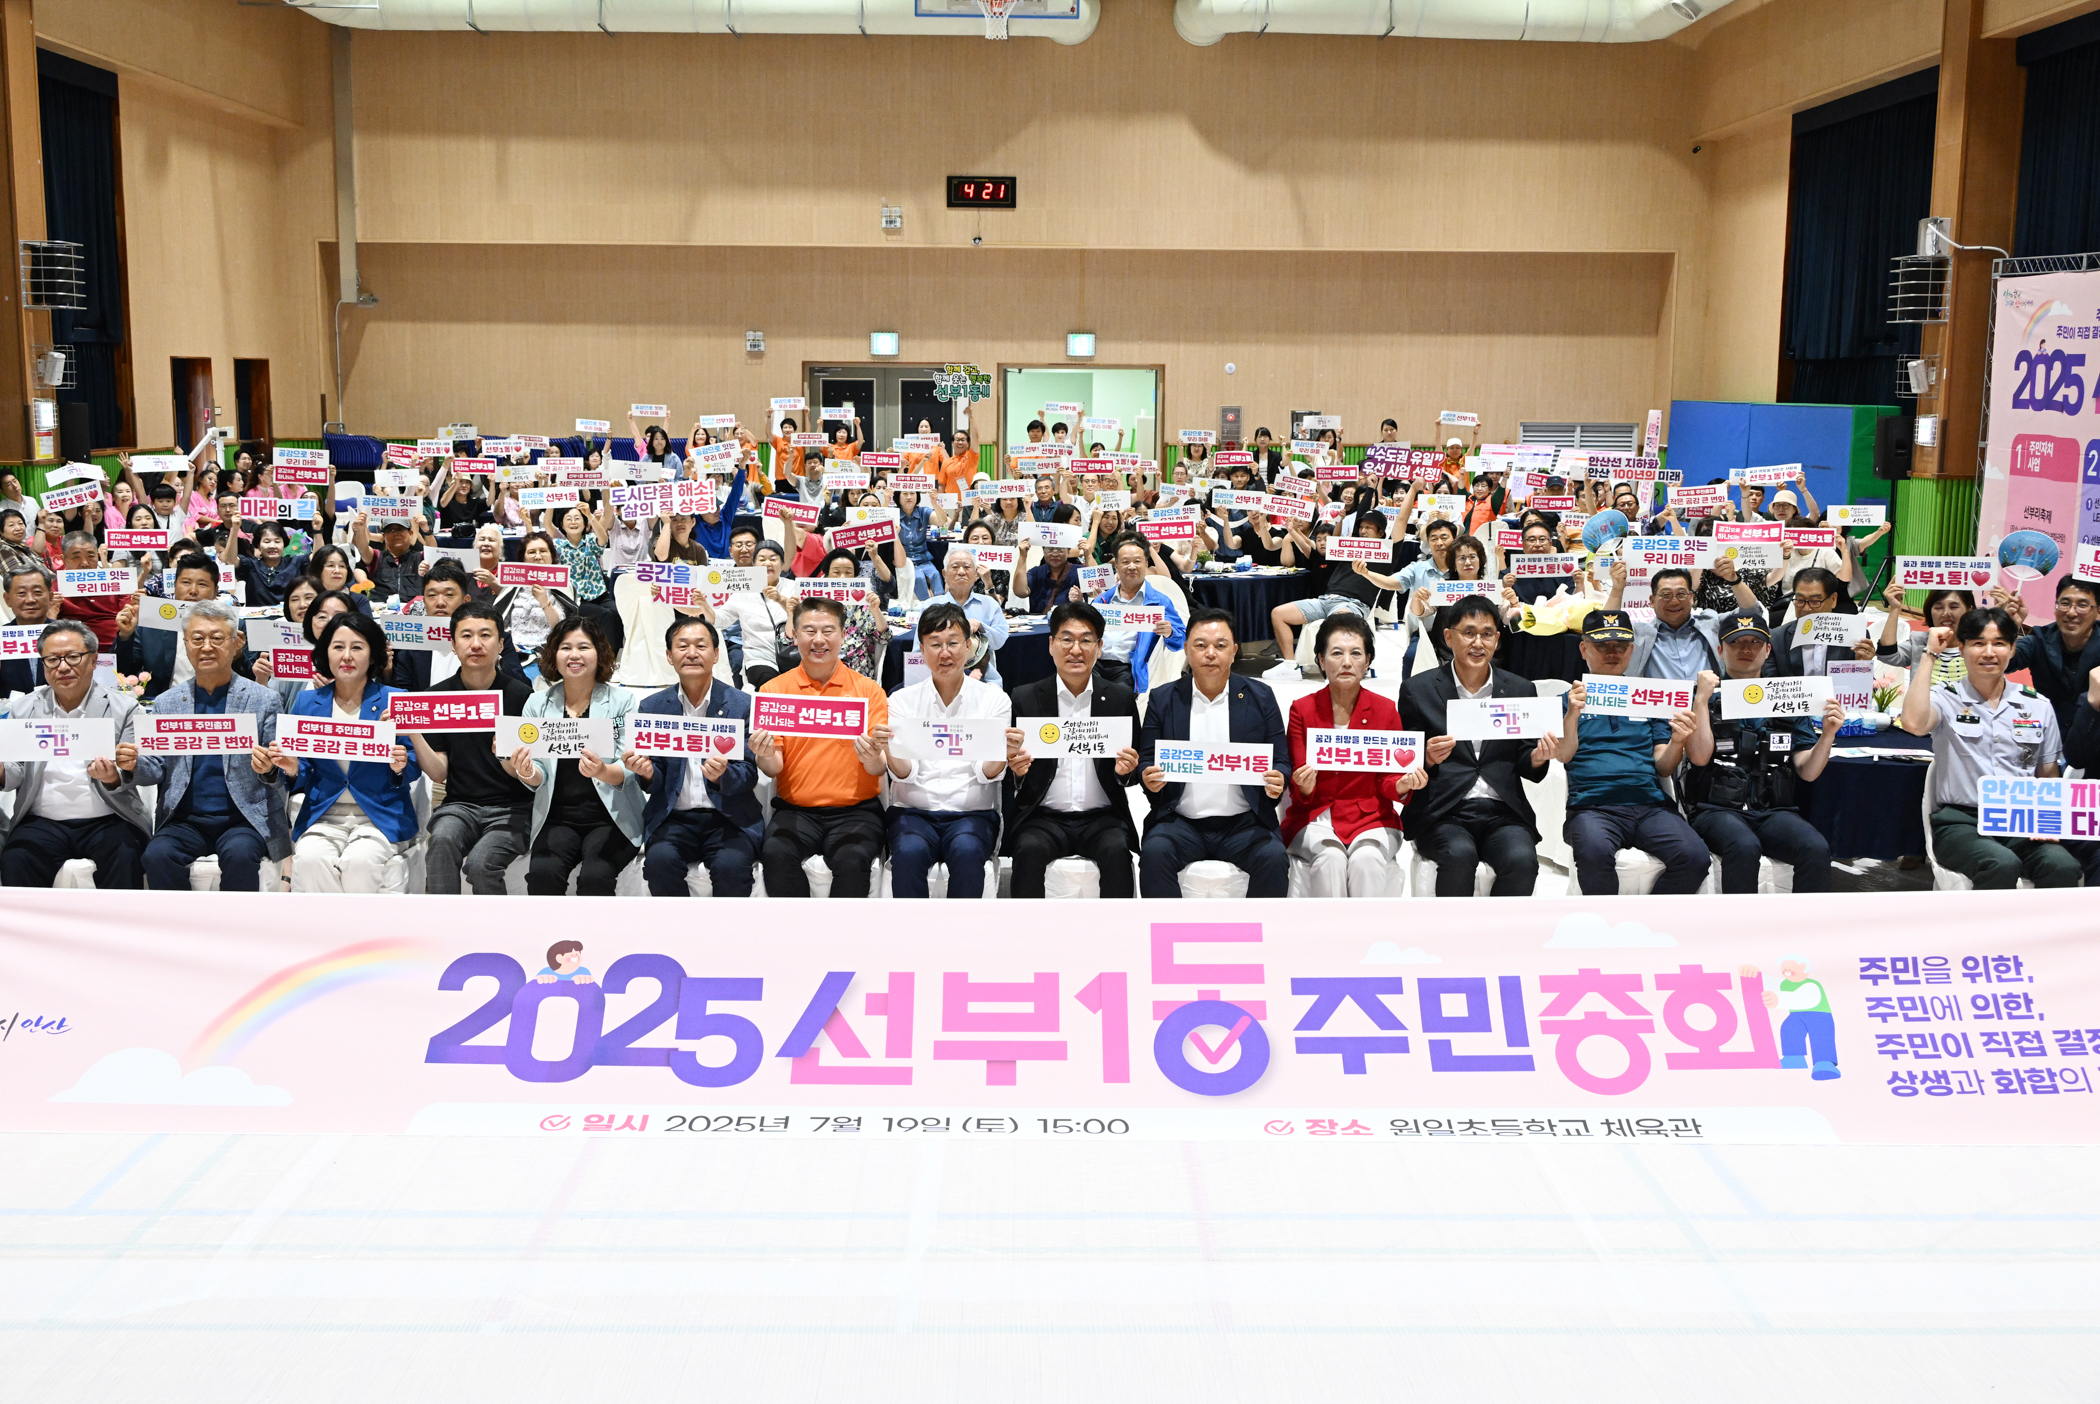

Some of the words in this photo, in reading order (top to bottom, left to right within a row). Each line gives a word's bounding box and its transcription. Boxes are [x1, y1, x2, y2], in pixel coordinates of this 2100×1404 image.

[982, 183, 1004, 199] 21
[2056, 326, 2075, 339] 주민이
[2077, 326, 2090, 340] 직접
[946, 366, 960, 374] 함께
[935, 375, 949, 383] 함께
[969, 375, 991, 384] 행복한
[2012, 349, 2086, 416] 2025
[935, 385, 990, 402] 선부1동!!
[696, 446, 720, 456] 공감으로
[1366, 447, 1408, 463] “수도권
[1410, 451, 1444, 465] 유일”
[2016, 444, 2022, 468] 1
[2029, 441, 2054, 457] 주민자치
[1088, 462, 1112, 470] 선부1동
[1589, 457, 1622, 468] 안산선
[1625, 457, 1659, 469] 지하화
[2028, 458, 2040, 472] 사업
[2087, 450, 2098, 476] 2
[1362, 462, 1386, 475] 우선
[1389, 464, 1410, 478] 사업
[1413, 467, 1441, 482] 선정!
[1589, 469, 1610, 479] 안산
[1613, 470, 1655, 480] 100년의
[1658, 471, 1680, 482] 미래
[612, 484, 672, 503] 도시단절
[678, 481, 713, 496] 해소!
[1000, 485, 1025, 493] 선부1동
[240, 499, 292, 518] 미래의
[297, 500, 314, 519] 길
[624, 502, 653, 518] 삶의
[659, 501, 674, 512] 질
[679, 497, 714, 511] 상승!
[1549, 499, 1573, 507] 선부1동
[1153, 508, 1180, 517] 공감으로
[2024, 506, 2052, 524] 선부리축제
[857, 525, 892, 540] 선부1동
[1161, 526, 1192, 535] 선부1동
[1742, 527, 1780, 538] 선부1동
[1632, 539, 1680, 550] 공감으로
[1684, 540, 1708, 551] 잇는
[1800, 533, 1833, 543] 선부1동
[978, 551, 1013, 563] 선부1동
[1644, 553, 1667, 564] 우리
[1671, 554, 1695, 565] 마을
[65, 571, 106, 582] 공감으로
[109, 570, 129, 581] 잇는
[527, 570, 565, 582] 선부1동
[637, 563, 691, 584] 공간을
[1904, 570, 1968, 586] 선부1동!
[77, 584, 97, 593] 우리
[100, 583, 121, 593] 마을
[1437, 583, 1474, 592] 공감으로
[1477, 583, 1496, 592] 잇는
[385, 622, 423, 632] 공감으로
[277, 653, 308, 661] 공감으로
[278, 665, 309, 674] 하나되는
[1586, 682, 1628, 695] 공감으로
[1586, 696, 1628, 708] 하나되는
[1631, 688, 1690, 708] 선부1동
[394, 701, 430, 712] 공감으로
[433, 703, 496, 720] 선부1동
[760, 702, 796, 713] 공감으로
[394, 714, 430, 725] 하나되는
[758, 715, 796, 727] 하나되는
[799, 708, 861, 726] 선부1동
[160, 720, 192, 732] 선부1동
[196, 720, 232, 730] 주민총회
[301, 723, 333, 734] 선부1동
[336, 725, 371, 736] 주민총회
[634, 719, 651, 728] 꿈과
[654, 720, 680, 730] 희망을
[683, 722, 708, 732] 만드는
[711, 723, 736, 734] 사람들
[141, 737, 170, 750] 작은
[174, 737, 202, 750] 공감
[206, 736, 220, 748] 큰
[224, 736, 254, 749] 변화
[281, 736, 308, 752] 작은
[313, 740, 341, 754] 공감
[344, 742, 358, 756] 큰
[362, 743, 390, 758] 변화
[634, 732, 710, 752] 선부1동!
[1316, 735, 1332, 744] 꿈과
[1335, 736, 1360, 744] 희망을
[1363, 736, 1388, 746] 만드는
[1392, 737, 1416, 746] 사람들
[1160, 748, 1204, 760] 공감으로
[1316, 746, 1391, 768] 선부1동!
[1160, 762, 1204, 774] 하나되는
[1207, 754, 1269, 773] 선부1동
[1982, 780, 2061, 806] 안산선
[2070, 784, 2100, 808] 지
[1983, 808, 2062, 834] 도시를
[1858, 956, 1952, 986] 주민을
[1961, 955, 2034, 984] 위한,
[424, 952, 764, 1088] 2025
[775, 922, 1270, 1097] 선부1동
[1290, 964, 1781, 1096] 주민총회
[1865, 994, 1962, 1023] 주민에
[1970, 992, 2044, 1021] 의한,
[1874, 1032, 1974, 1060] 주민이
[1980, 1030, 2048, 1058] 직접
[1886, 1069, 1985, 1097] 상생과
[1990, 1066, 2093, 1094] 화합의
[582, 1114, 649, 1132] 일시
[664, 1115, 790, 1134] 2025년
[809, 1116, 862, 1134] 7월
[1037, 1116, 1130, 1136] 15:00
[1306, 1118, 1374, 1136] 장소
[1389, 1118, 1594, 1138] 원일초등학교
[1600, 1118, 1702, 1138] 체육관
